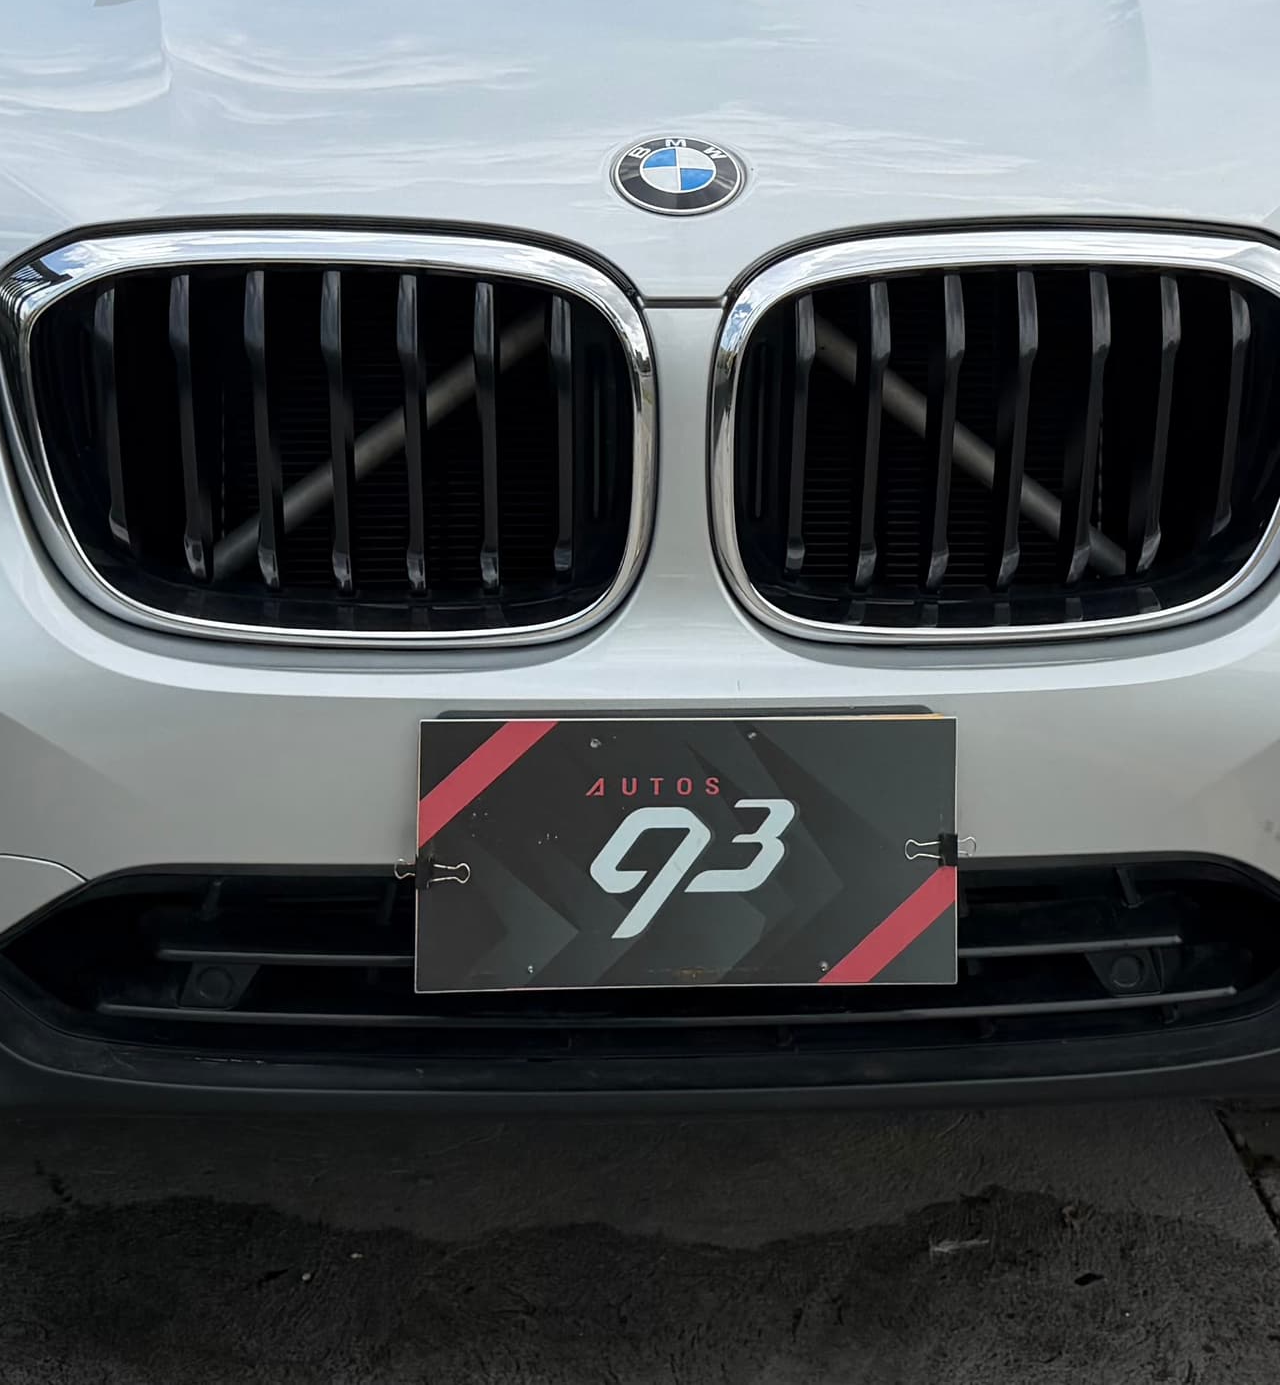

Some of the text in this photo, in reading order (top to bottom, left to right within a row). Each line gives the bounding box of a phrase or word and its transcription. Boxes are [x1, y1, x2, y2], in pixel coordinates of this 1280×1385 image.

[628, 138, 727, 159] BMW
[585, 776, 720, 796] AUTOS
[589, 798, 795, 939] 93
